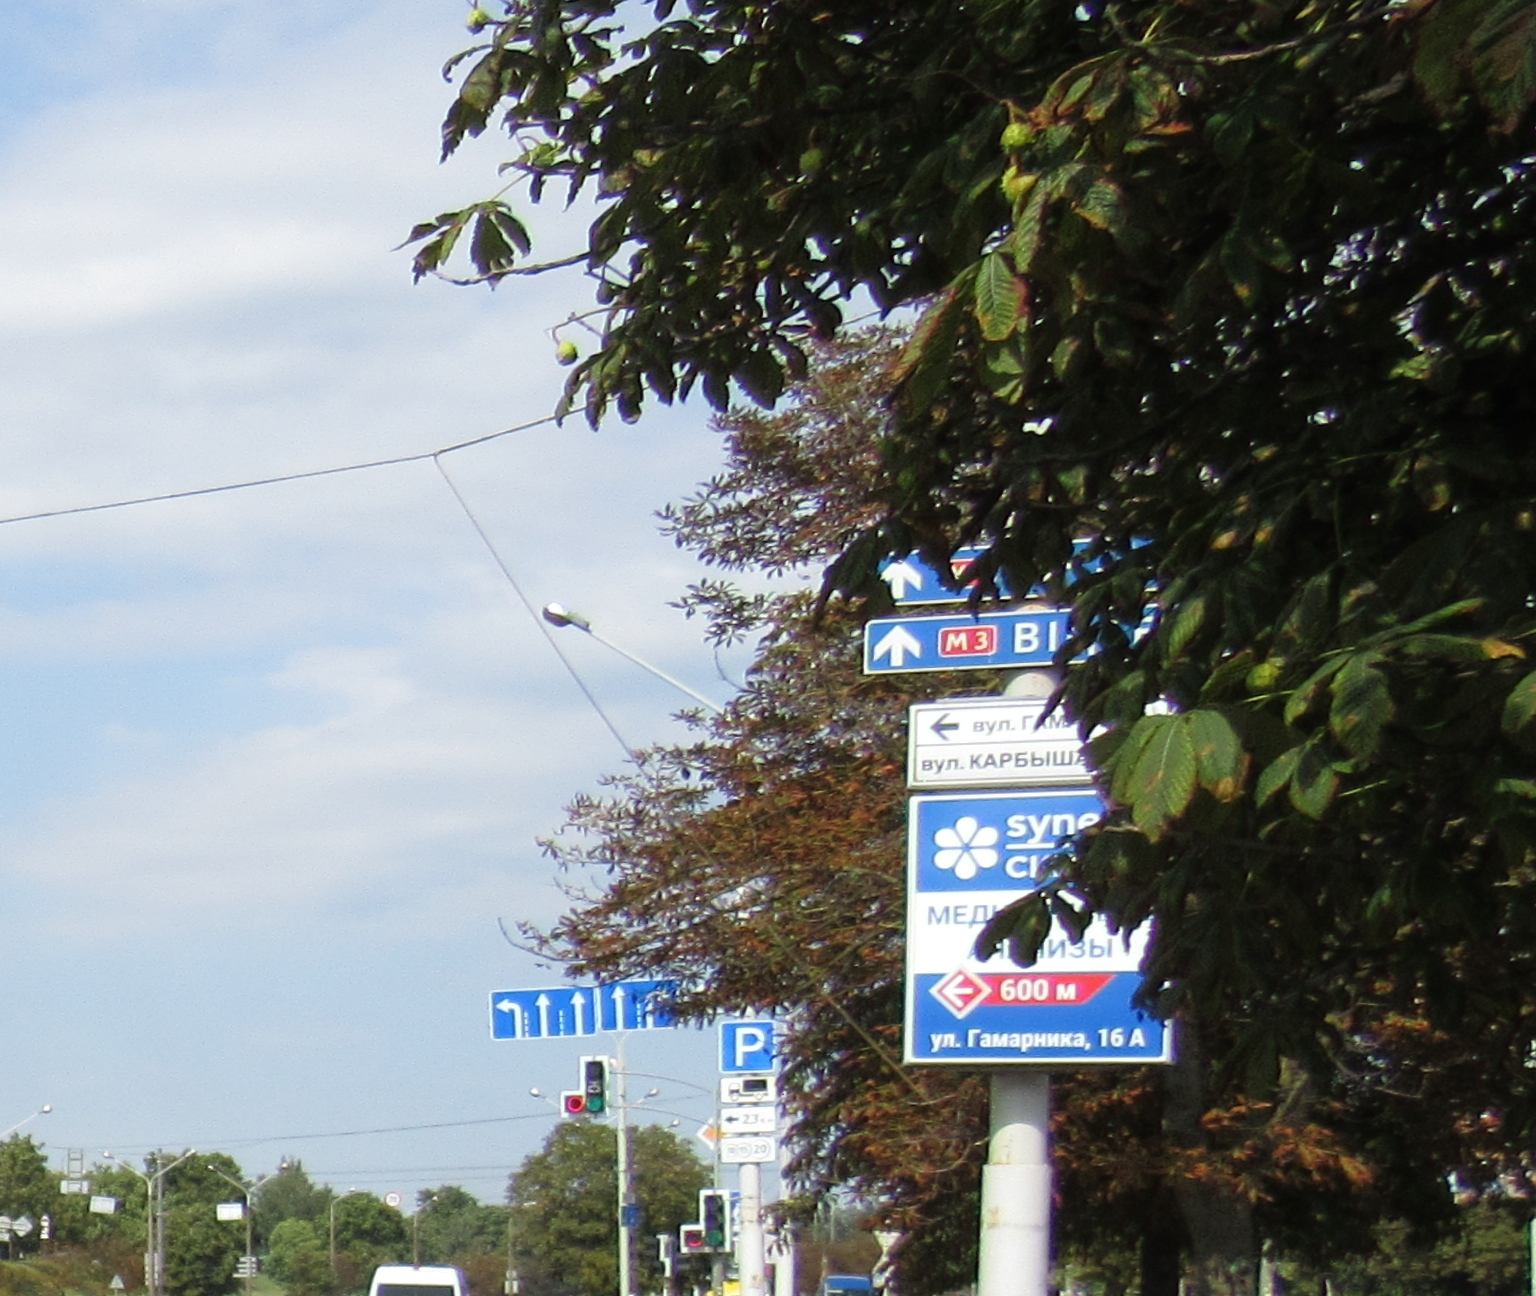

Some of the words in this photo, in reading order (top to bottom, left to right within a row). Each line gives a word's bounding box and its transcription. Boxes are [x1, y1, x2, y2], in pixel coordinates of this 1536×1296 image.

[973, 716, 1016, 735] вул.
[921, 759, 965, 775] вул.
[1006, 812, 1102, 844] syne
[1000, 979, 1049, 1001] 600
[735, 1028, 766, 1067] P
[930, 1033, 961, 1051] ул.
[968, 1029, 1091, 1052] Гамарника,
[1098, 1029, 1124, 1047] 16
[753, 1144, 767, 1154] 20
